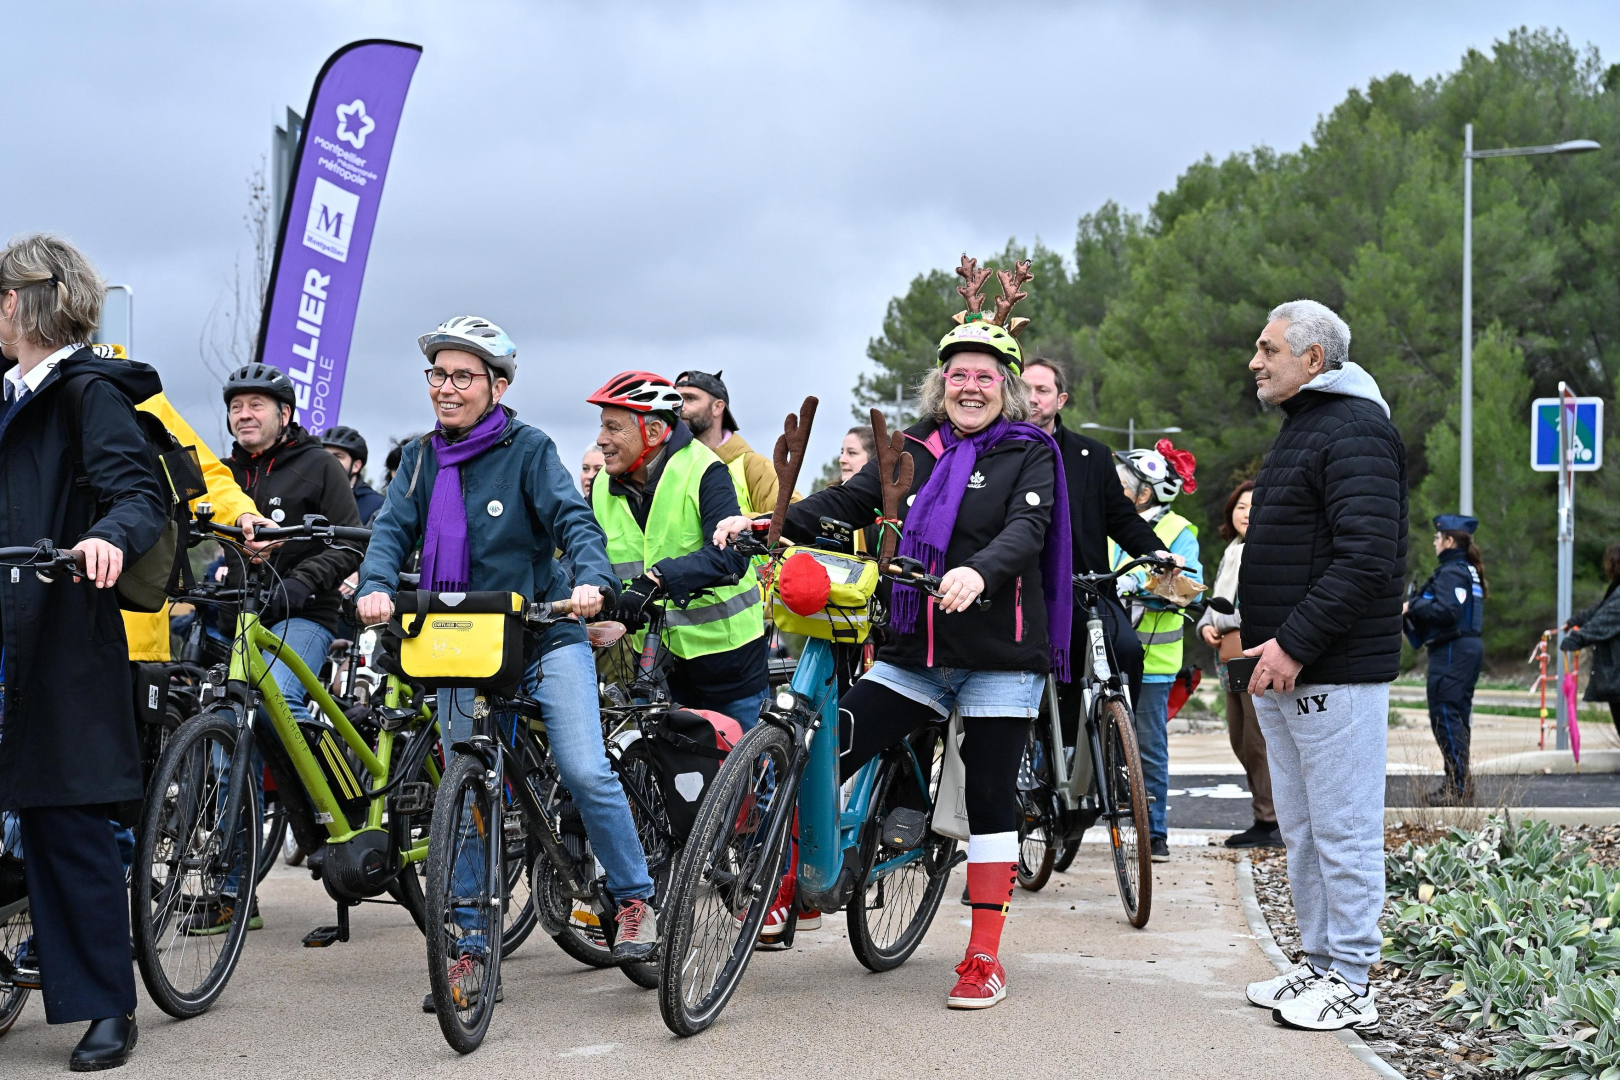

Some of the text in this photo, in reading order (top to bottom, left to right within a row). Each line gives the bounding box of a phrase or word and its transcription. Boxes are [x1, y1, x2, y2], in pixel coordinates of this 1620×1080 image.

[314, 135, 367, 168] Montpellier
[318, 157, 367, 186] Métropole
[316, 203, 344, 240] M
[1296, 693, 1328, 716] NY
[275, 692, 309, 753] KALKHOFF
